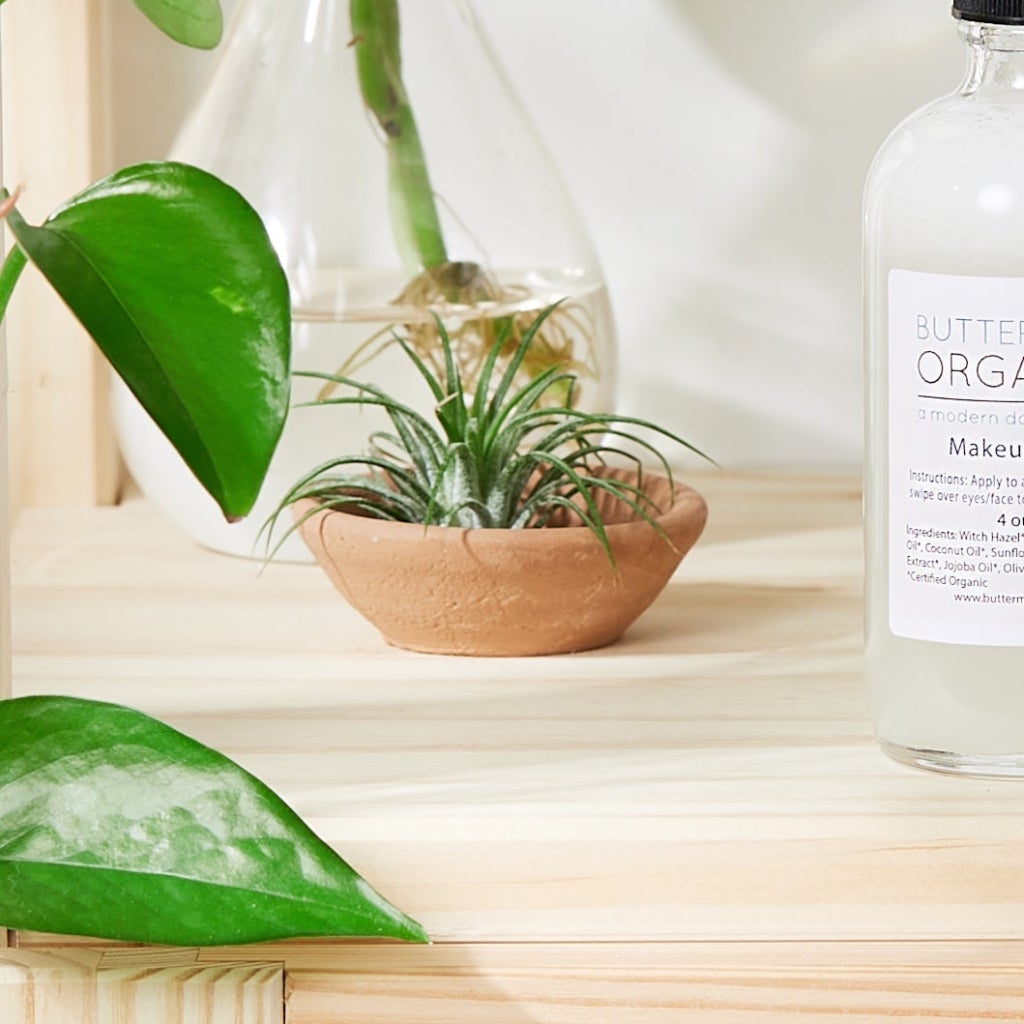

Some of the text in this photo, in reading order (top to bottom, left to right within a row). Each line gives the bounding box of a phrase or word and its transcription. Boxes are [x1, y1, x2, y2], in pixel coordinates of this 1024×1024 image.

[917, 408, 926, 421] a
[930, 409, 998, 425] modern
[909, 468, 968, 486] Instructions:
[971, 474, 1003, 490] Apply
[1006, 477, 1018, 487] to
[909, 488, 934, 502] swipe
[937, 491, 959, 502] over
[962, 493, 1014, 506] eyes/face
[997, 513, 1006, 526] 4
[906, 524, 957, 541] Ingredients:
[959, 530, 988, 542] Witch
[925, 542, 964, 556] Coconut
[944, 560, 975, 573] Jojoba
[948, 576, 988, 588] Organic
